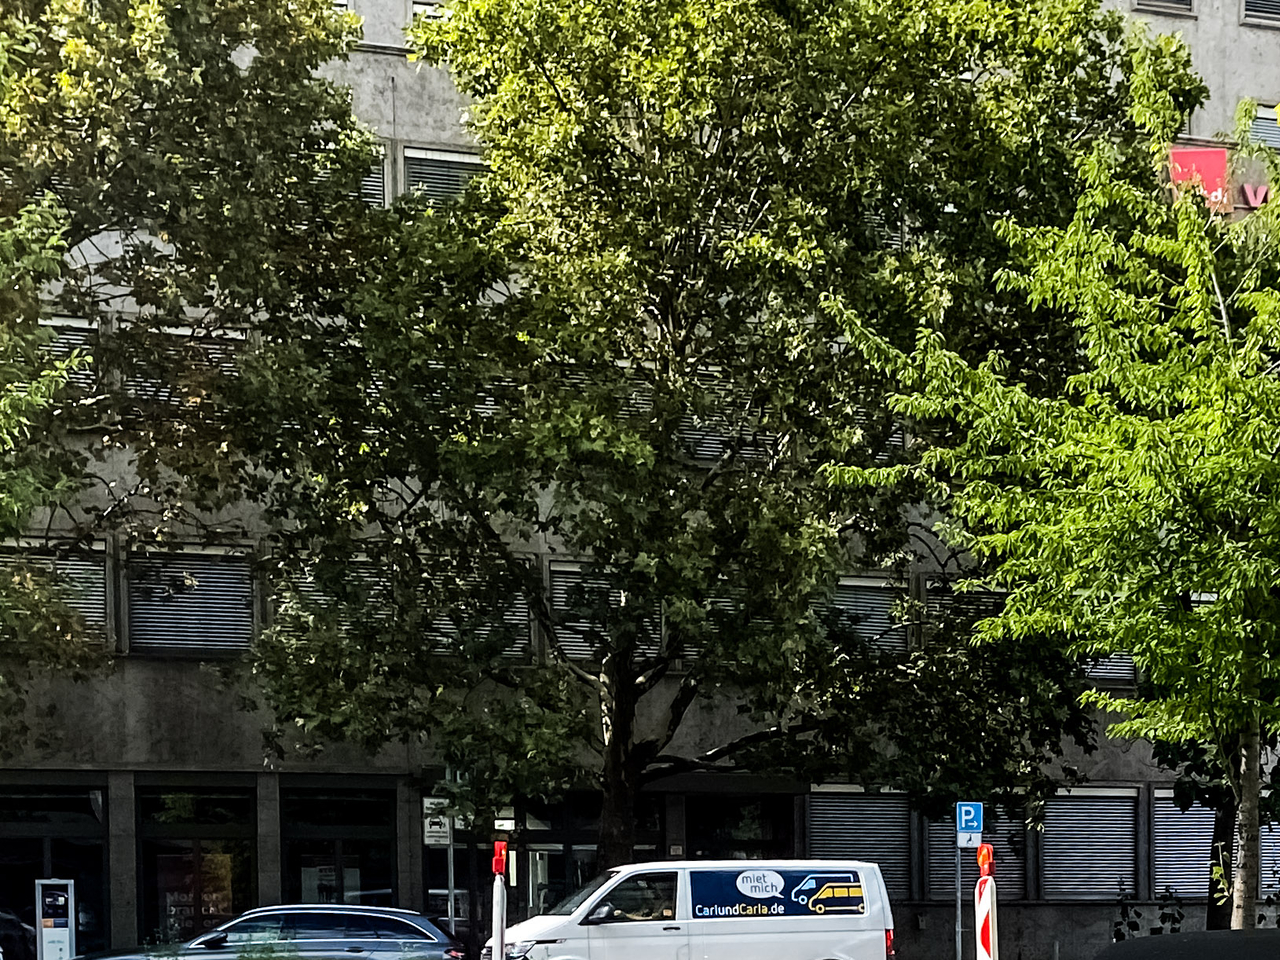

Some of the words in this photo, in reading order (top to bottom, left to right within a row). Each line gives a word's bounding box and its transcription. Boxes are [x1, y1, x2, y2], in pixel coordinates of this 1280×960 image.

[961, 806, 975, 828] P
[742, 872, 767, 884] miet
[750, 882, 778, 894] mich
[695, 903, 785, 916] CarlundCarla.de
